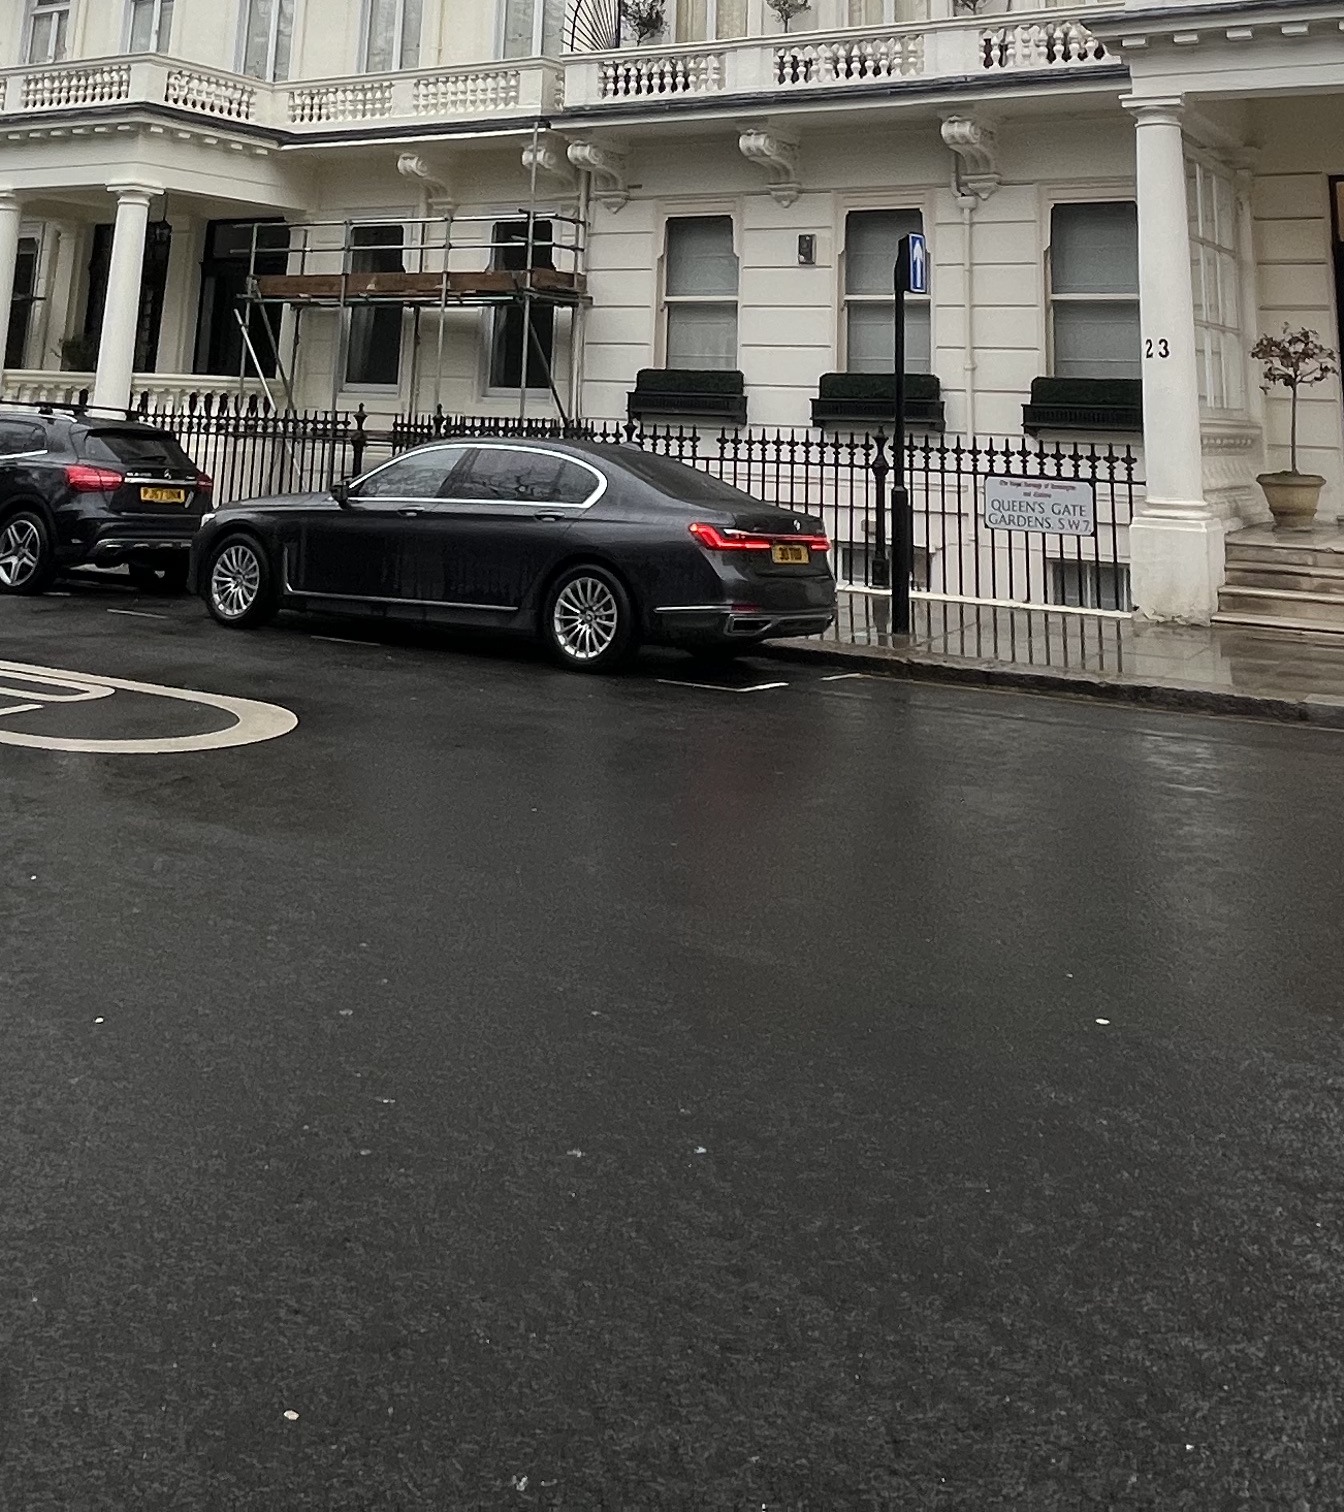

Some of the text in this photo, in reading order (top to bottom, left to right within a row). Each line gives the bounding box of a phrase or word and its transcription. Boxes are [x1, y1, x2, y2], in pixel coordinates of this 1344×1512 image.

[1146, 338, 1169, 358] 23
[991, 498, 1086, 517] QUEEN'S GATE
